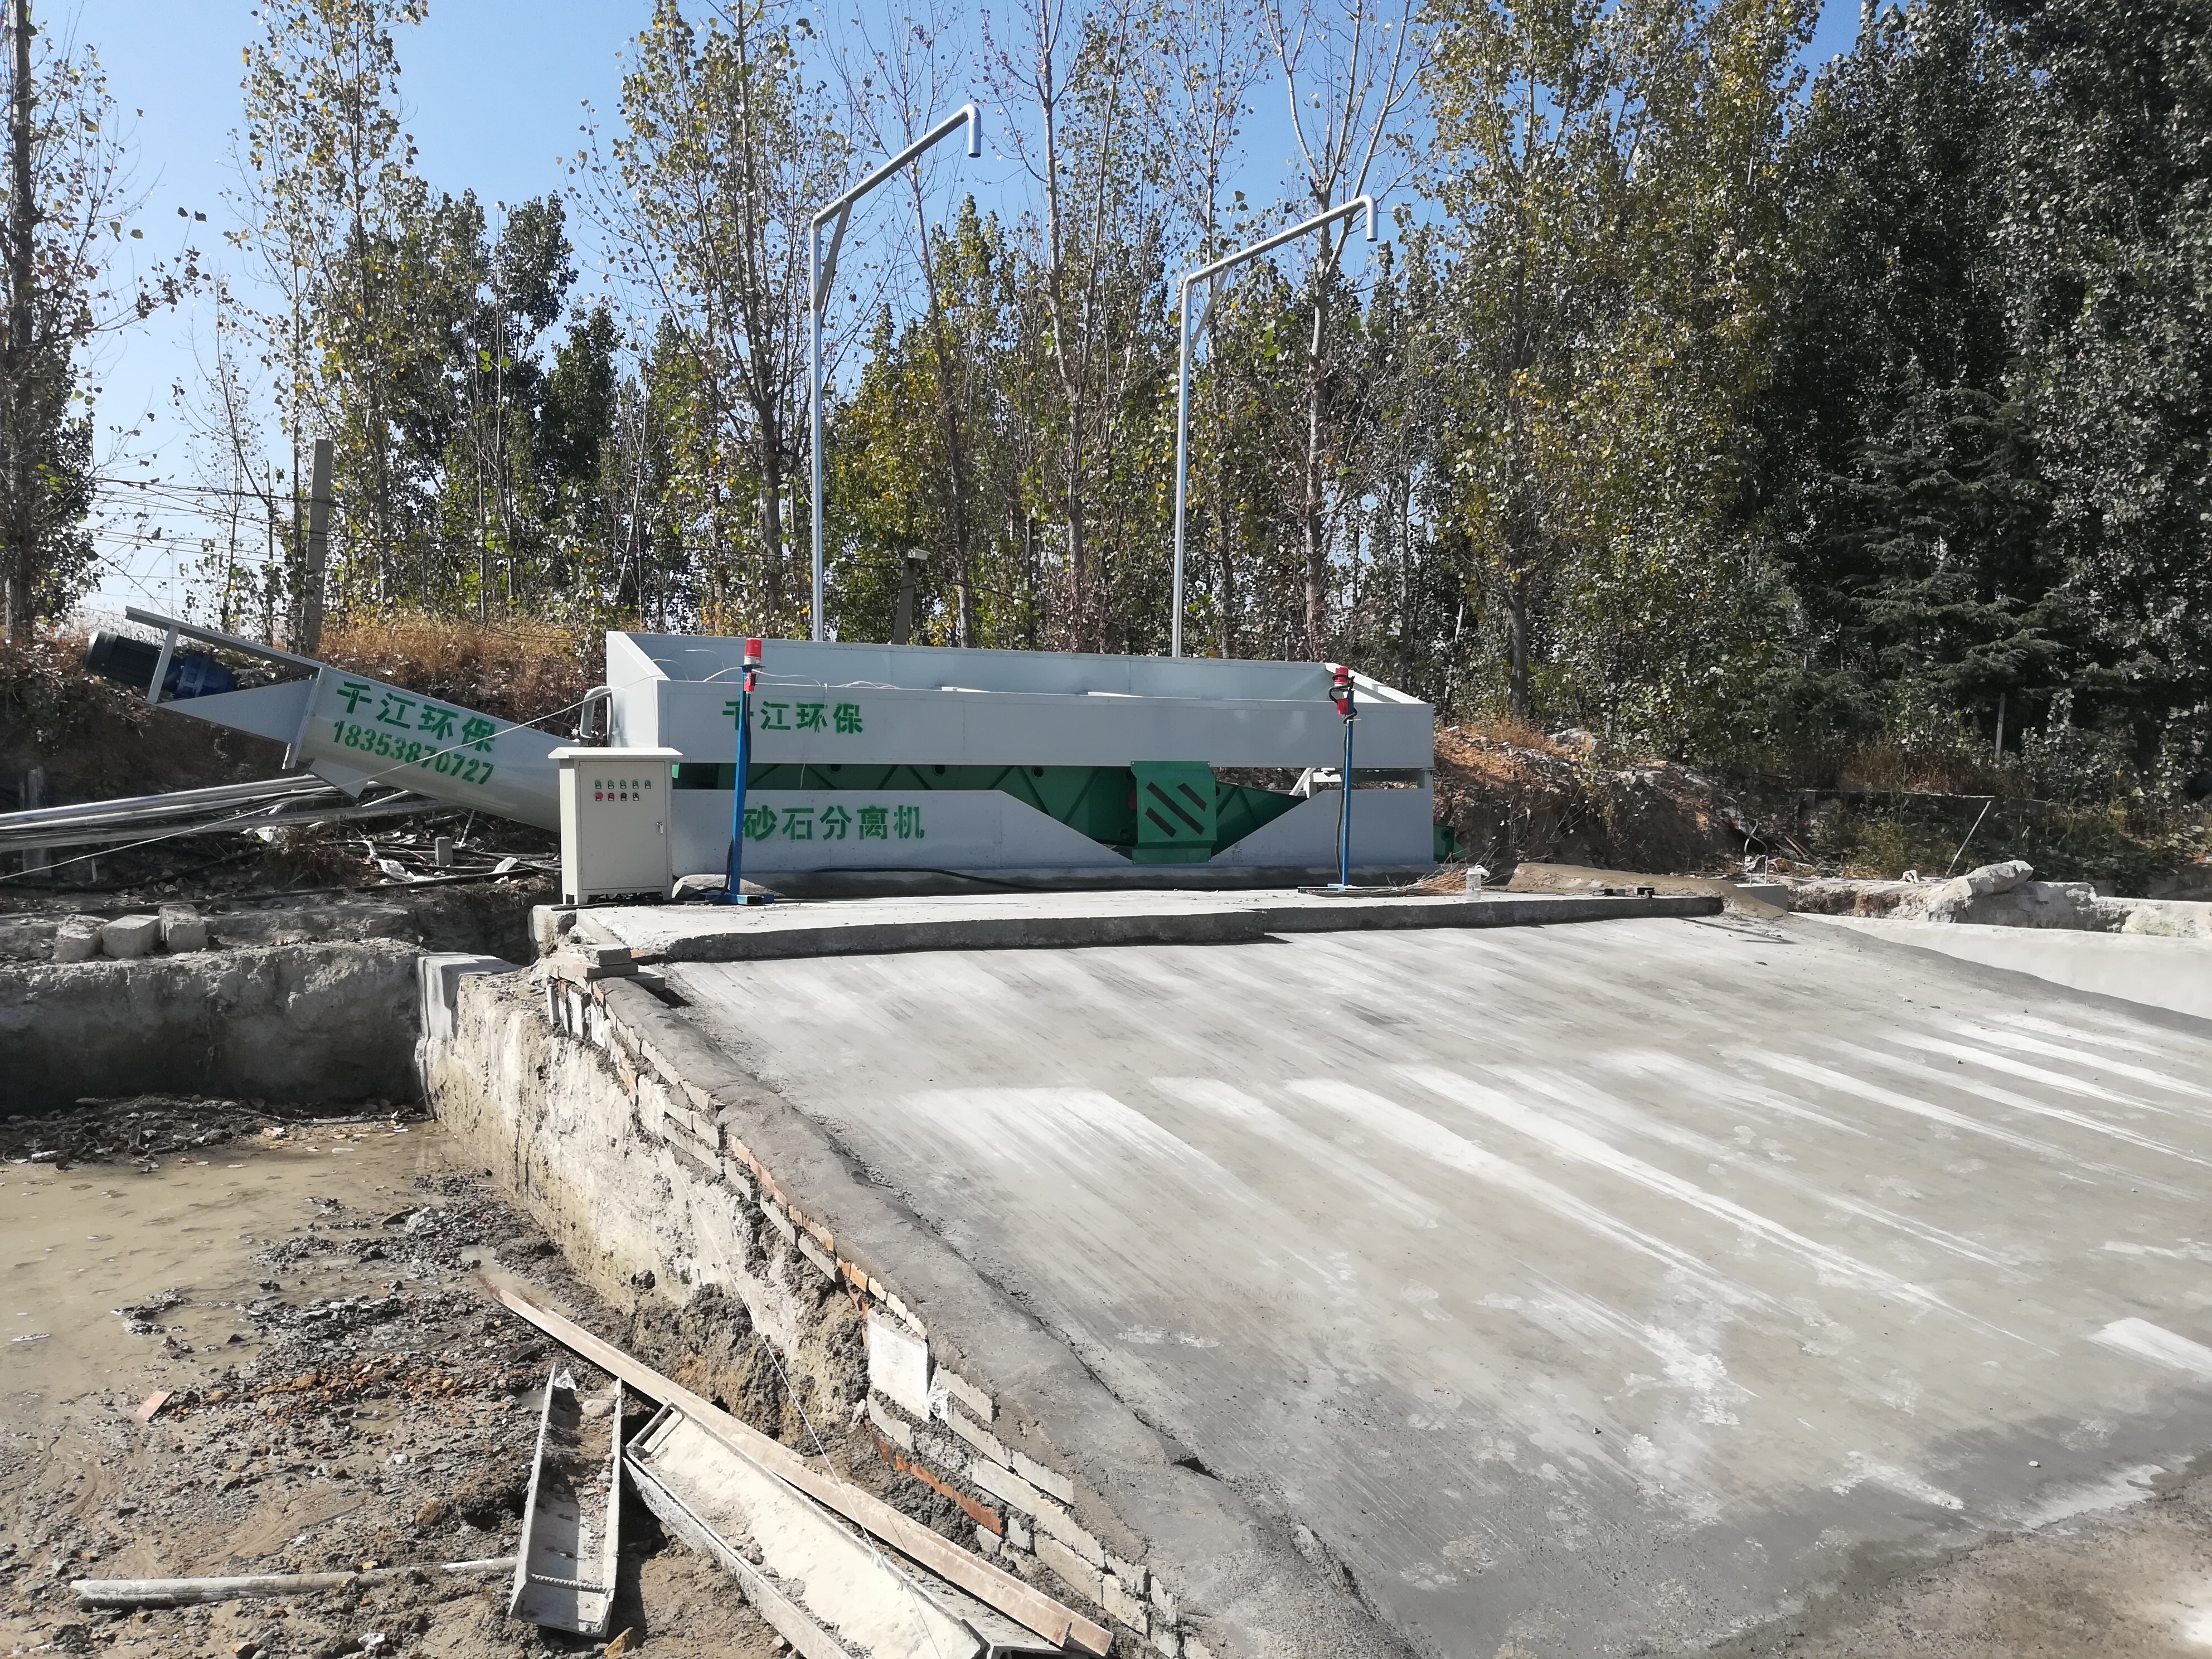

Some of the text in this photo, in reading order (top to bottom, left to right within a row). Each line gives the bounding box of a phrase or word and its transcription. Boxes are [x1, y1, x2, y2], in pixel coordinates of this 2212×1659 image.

[336, 681, 497, 753] 千江环保
[333, 720, 494, 785] 18353870727
[743, 804, 925, 842] 砂石分离机
